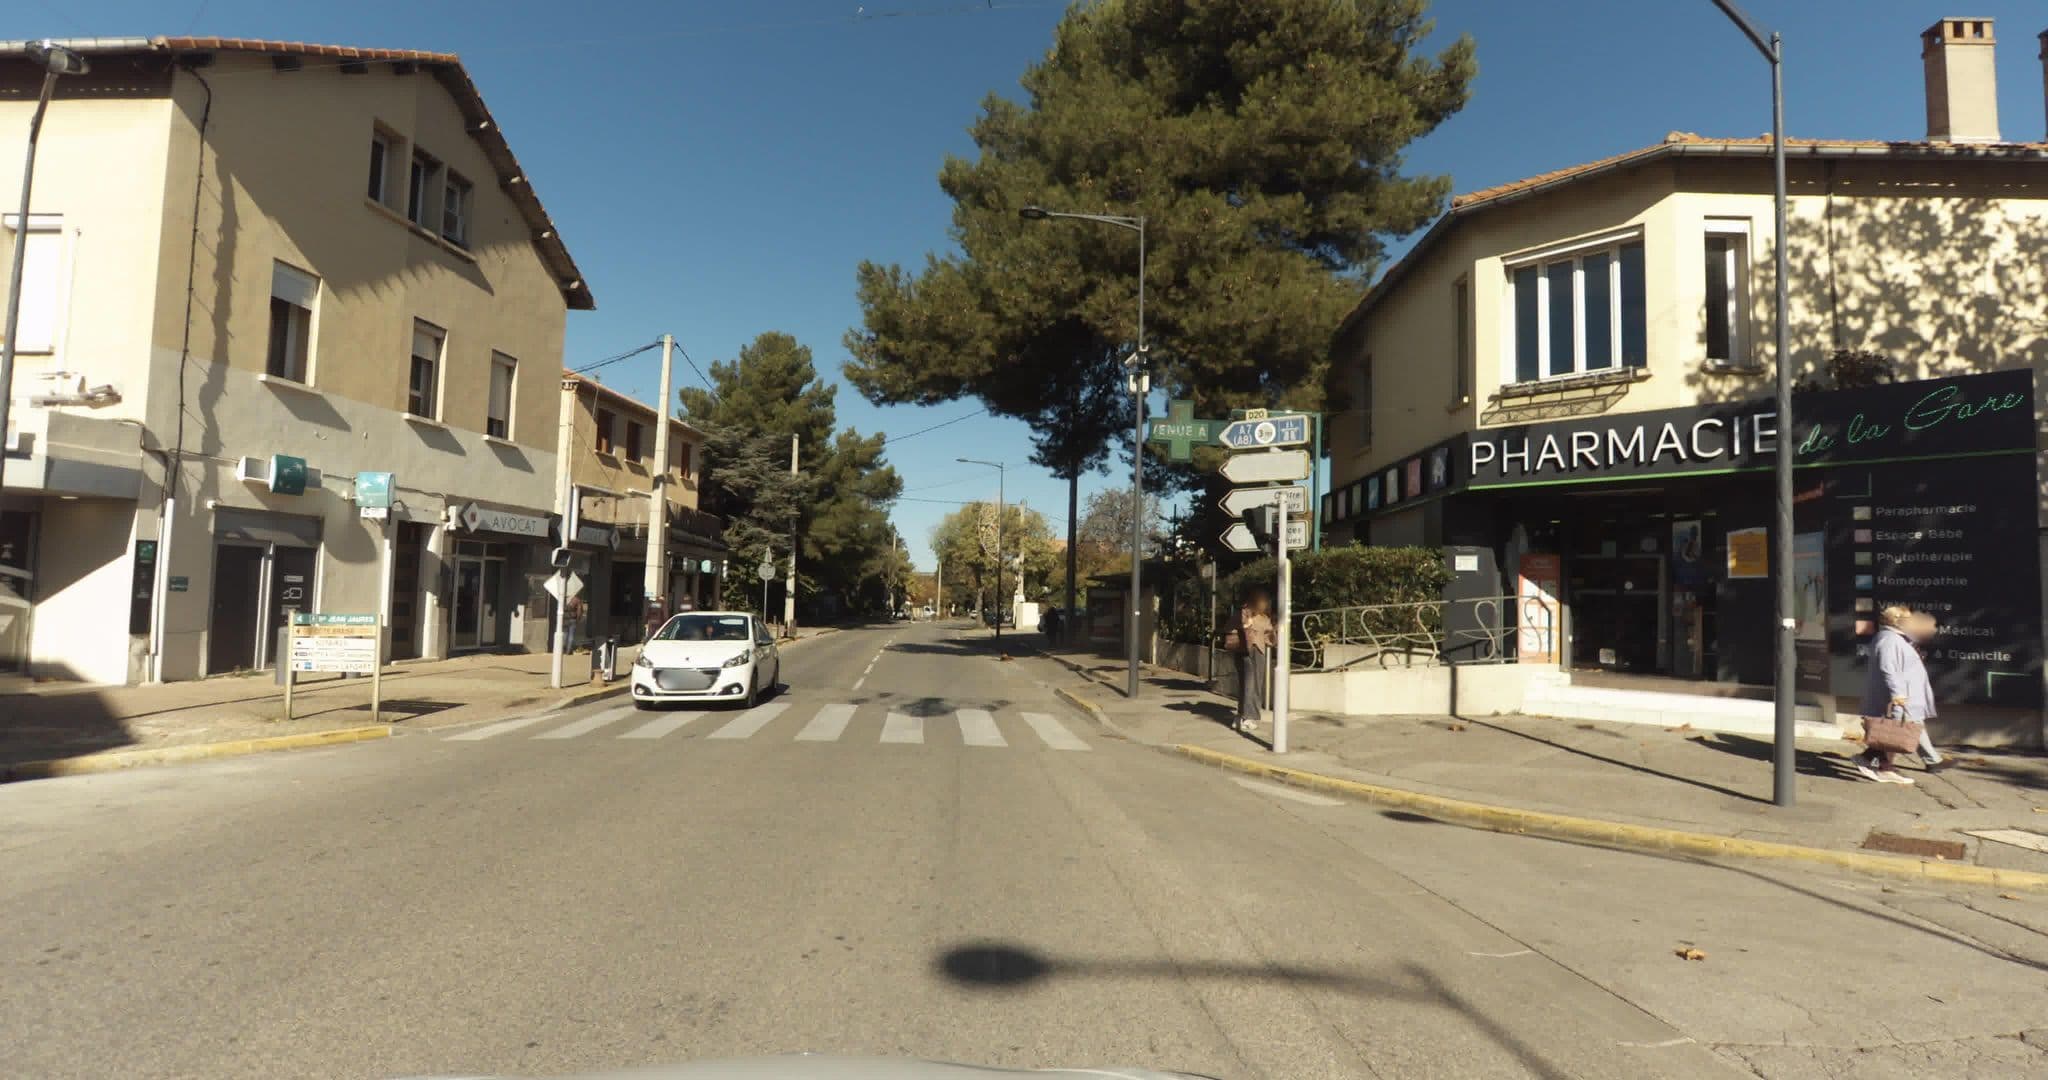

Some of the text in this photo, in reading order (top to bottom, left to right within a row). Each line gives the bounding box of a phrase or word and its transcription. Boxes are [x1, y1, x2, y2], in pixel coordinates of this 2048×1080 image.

[1248, 410, 1265, 420] D20
[1471, 385, 2025, 475] PHARMACIE de la Gare
[1233, 434, 1253, 446] (A8)
[491, 515, 537, 533] AVOCAT
[1875, 530, 1923, 542] Espace
[1948, 649, 2012, 662] Domicile
